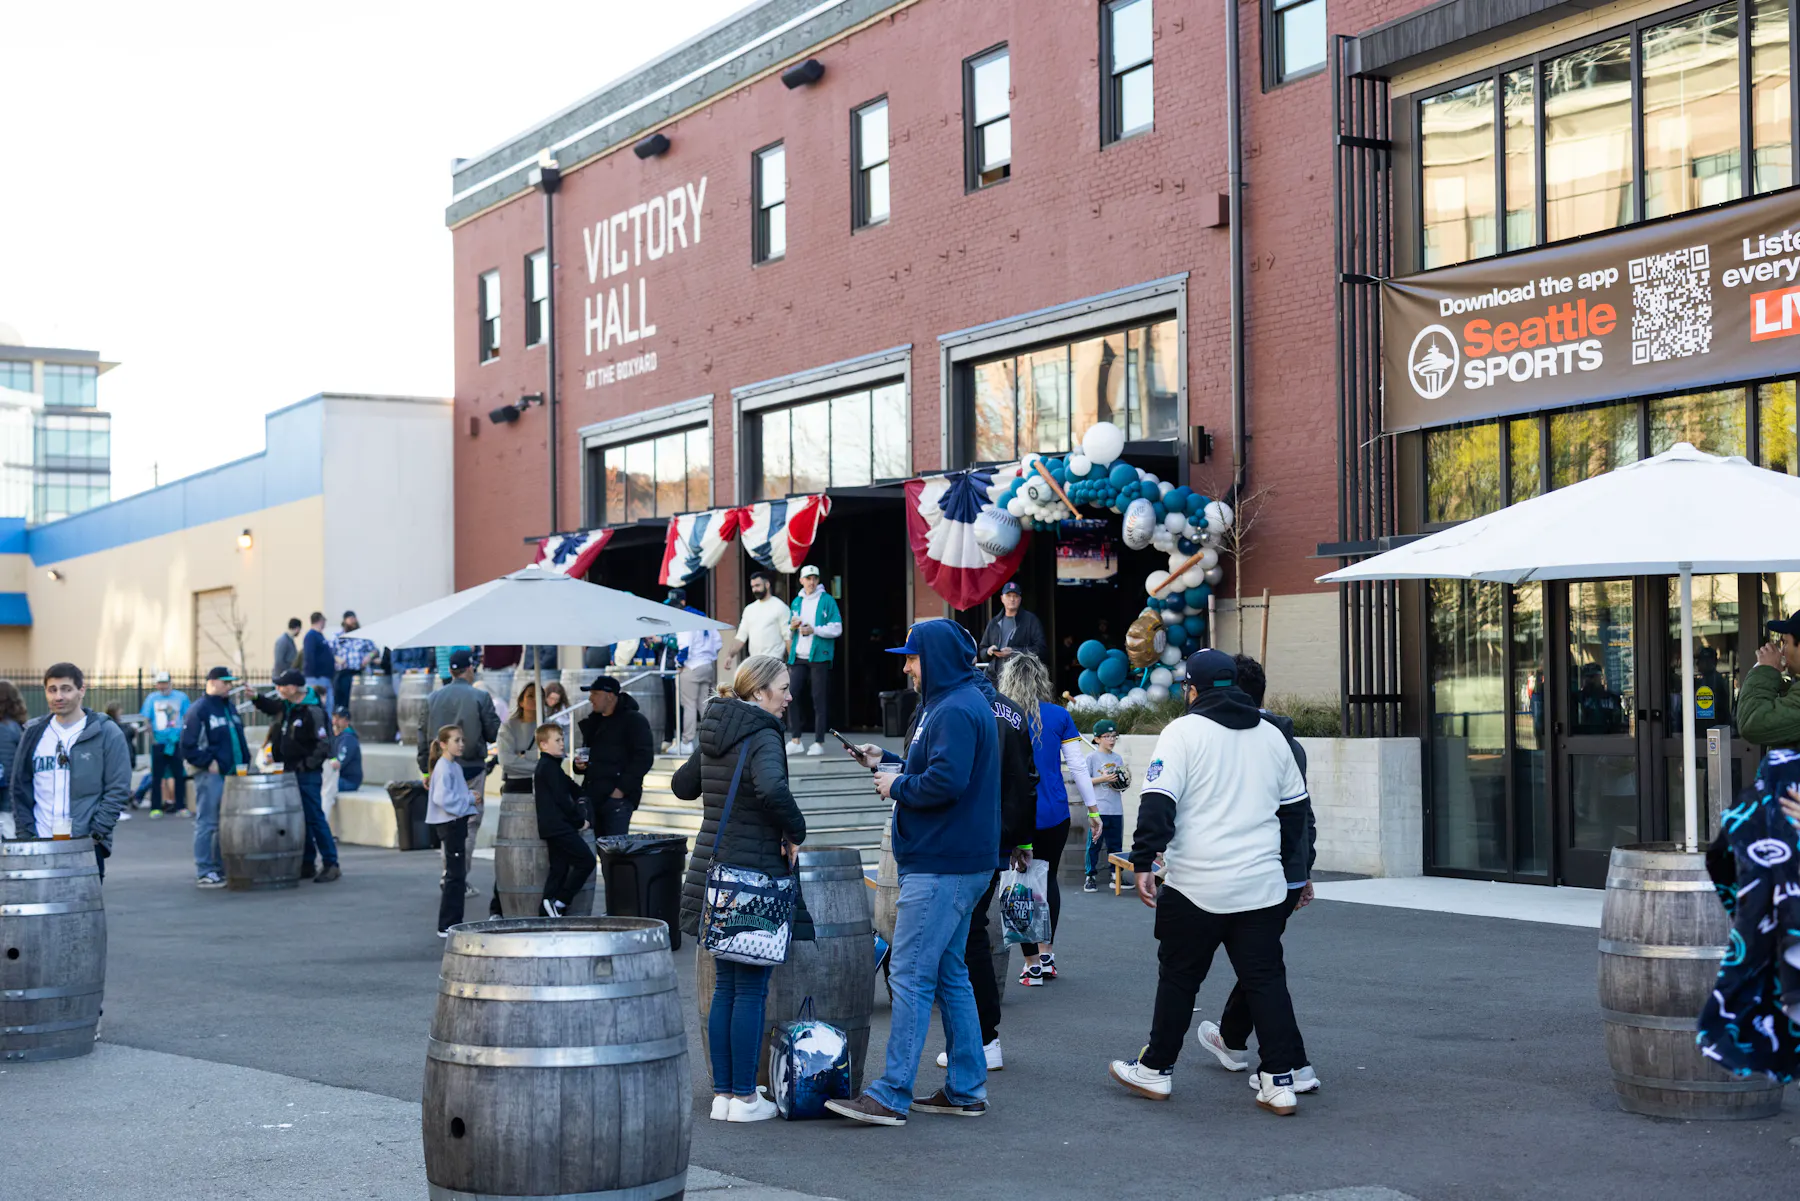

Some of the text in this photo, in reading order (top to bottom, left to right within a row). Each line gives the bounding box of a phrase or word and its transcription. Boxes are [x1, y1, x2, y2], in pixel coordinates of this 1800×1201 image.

[583, 176, 708, 284] VICTORY
[1439, 267, 1619, 317] Download the app
[1722, 256, 1800, 288] every
[585, 277, 657, 356] HALL
[1463, 298, 1617, 358] Seattle
[585, 352, 657, 390] AT THE BOXYARD
[1463, 339, 1604, 390] SPORTS
